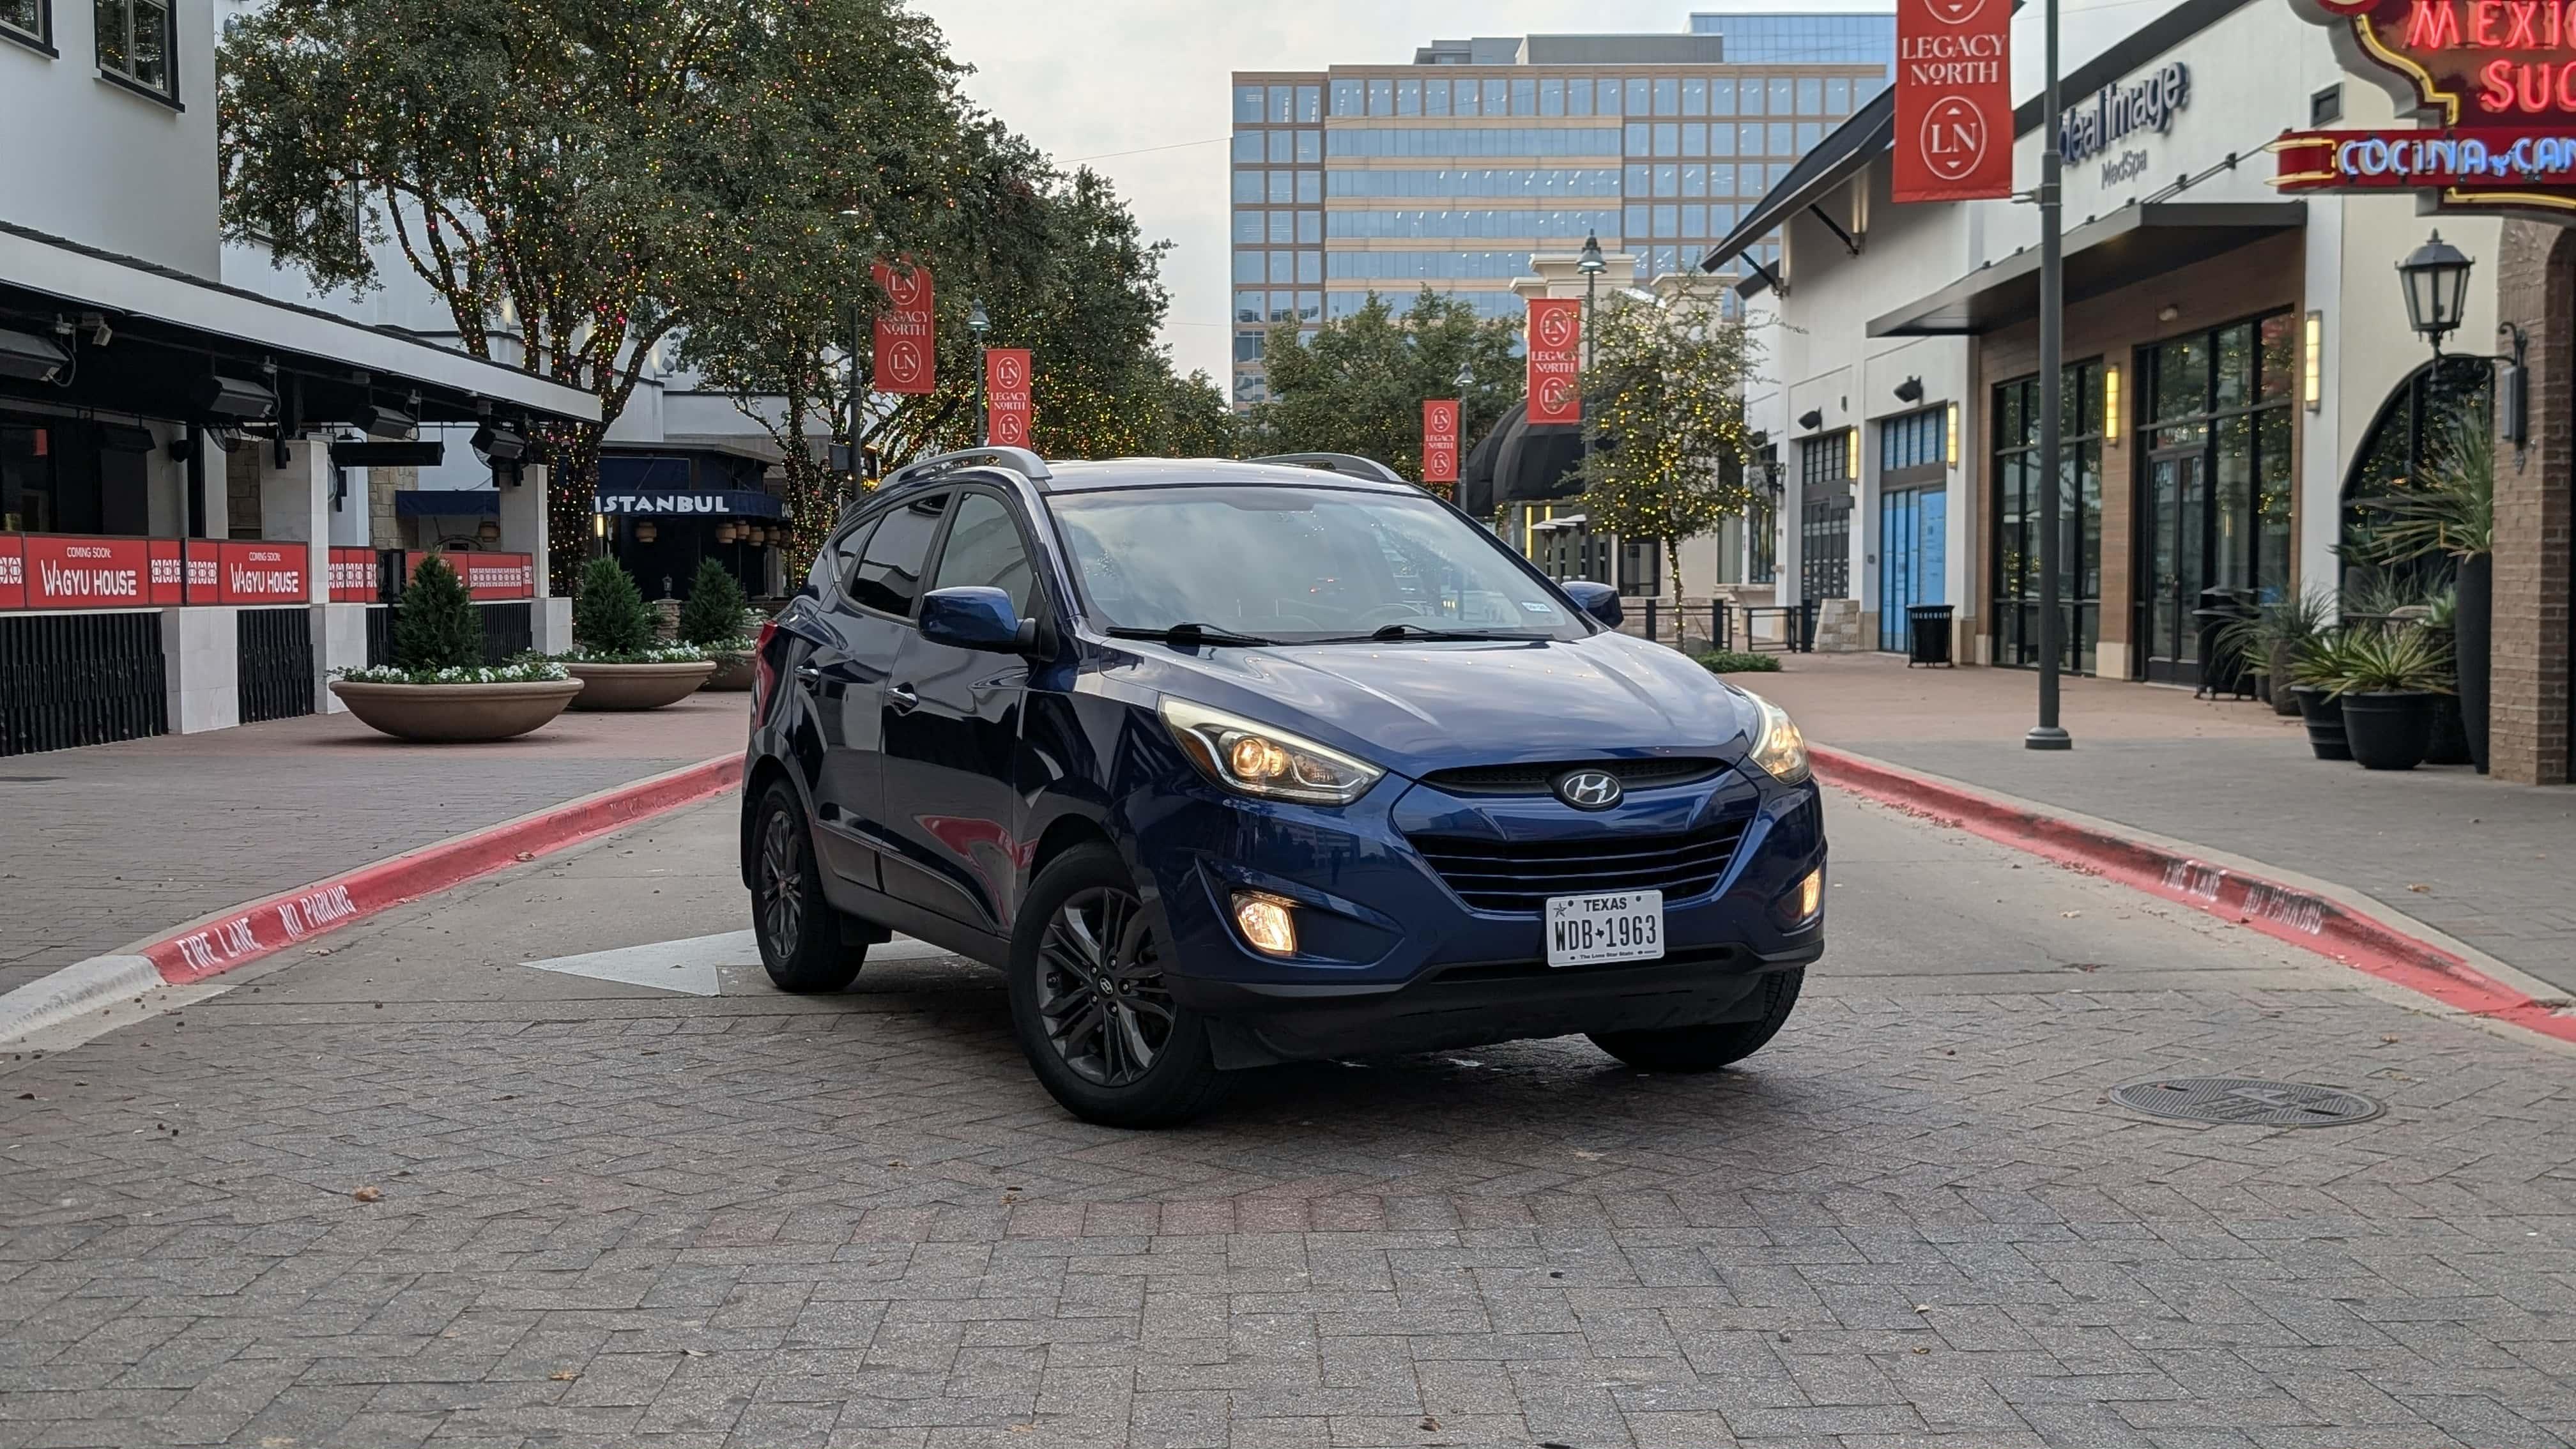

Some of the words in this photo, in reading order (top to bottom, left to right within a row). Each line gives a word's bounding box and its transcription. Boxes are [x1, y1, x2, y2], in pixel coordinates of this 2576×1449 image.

[1901, 34, 2006, 59] LEGACY
[1910, 61, 1998, 86] NORTH
[2058, 89, 2106, 165] deal
[1931, 123, 1977, 153] LN
[2336, 137, 2488, 176] COCINA
[882, 323, 926, 335] NORTH
[894, 353, 916, 370] LN
[1535, 362, 1574, 373] NORTH
[1000, 367, 1017, 379] LN
[990, 392, 1027, 401] LEGACY
[994, 402, 1025, 411] NORTH
[1002, 423, 1018, 435] LN
[595, 496, 730, 512] ISTANBUL
[66, 546, 91, 558] COMING
[41, 559, 90, 596] WAGYU
[93, 569, 137, 595] HOUSE
[230, 562, 265, 593] WAGYU
[267, 571, 299, 593] HOUSE
[1583, 897, 1627, 912] TEXAS
[174, 931, 224, 970] FIRE
[214, 917, 263, 958] LANE
[277, 903, 305, 941] NO
[299, 884, 357, 928] PARKING
